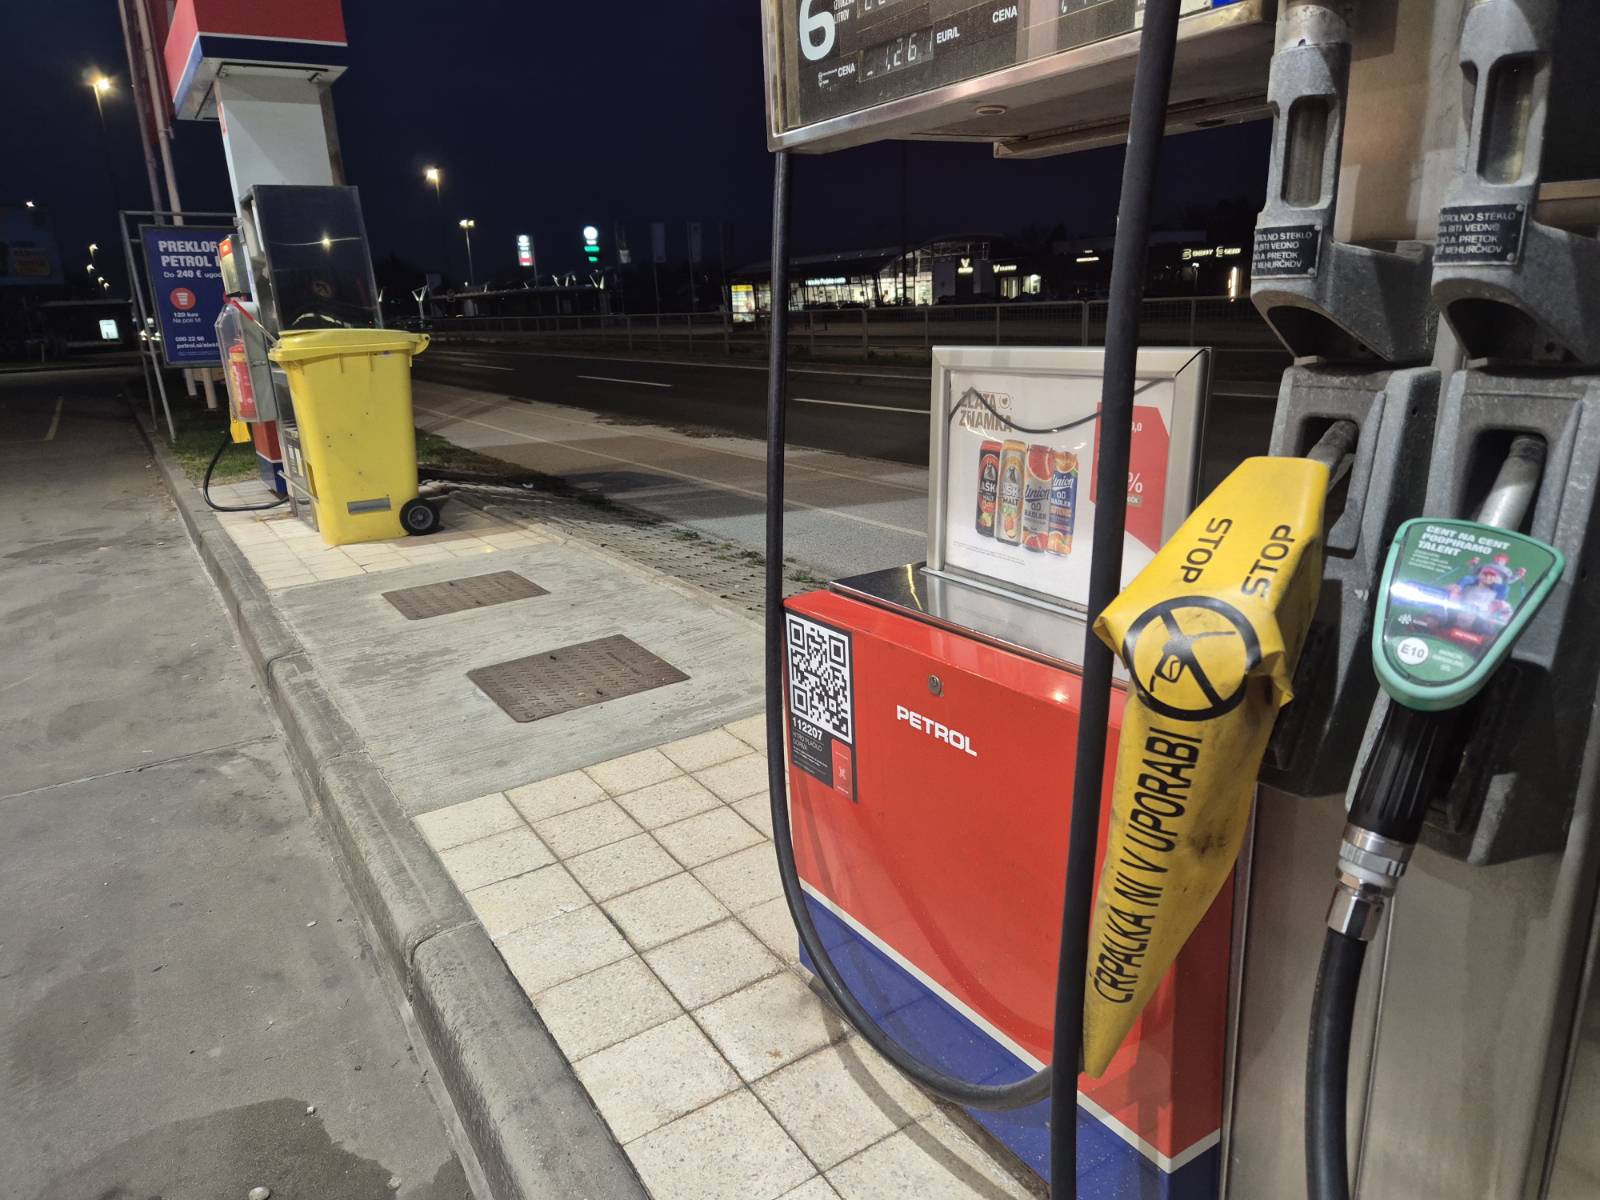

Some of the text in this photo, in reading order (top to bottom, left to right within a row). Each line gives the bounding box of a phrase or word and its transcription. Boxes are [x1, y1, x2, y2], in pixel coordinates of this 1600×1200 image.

[992, 5, 1018, 23] CENA
[799, 0, 836, 61] 6
[936, 26, 961, 44] EUR/L
[837, 62, 856, 77] CENA
[160, 255, 213, 267] PETROL
[195, 270, 202, 278] €
[960, 391, 997, 410] ZLATA
[959, 410, 1012, 432] ZNAMKA
[1417, 540, 1462, 557] TALENT
[1421, 532, 1493, 555] PODPIRAMO
[1425, 525, 1511, 550] CENT NA CENT
[1180, 517, 1233, 584] STOP
[1241, 523, 1296, 598] STOP
[1400, 643, 1426, 659] E10
[792, 716, 823, 741] 112207
[896, 704, 978, 757] PETROL
[1125, 726, 1203, 853] UPORABI
[1120, 846, 1169, 873] V
[1113, 871, 1164, 907] NI
